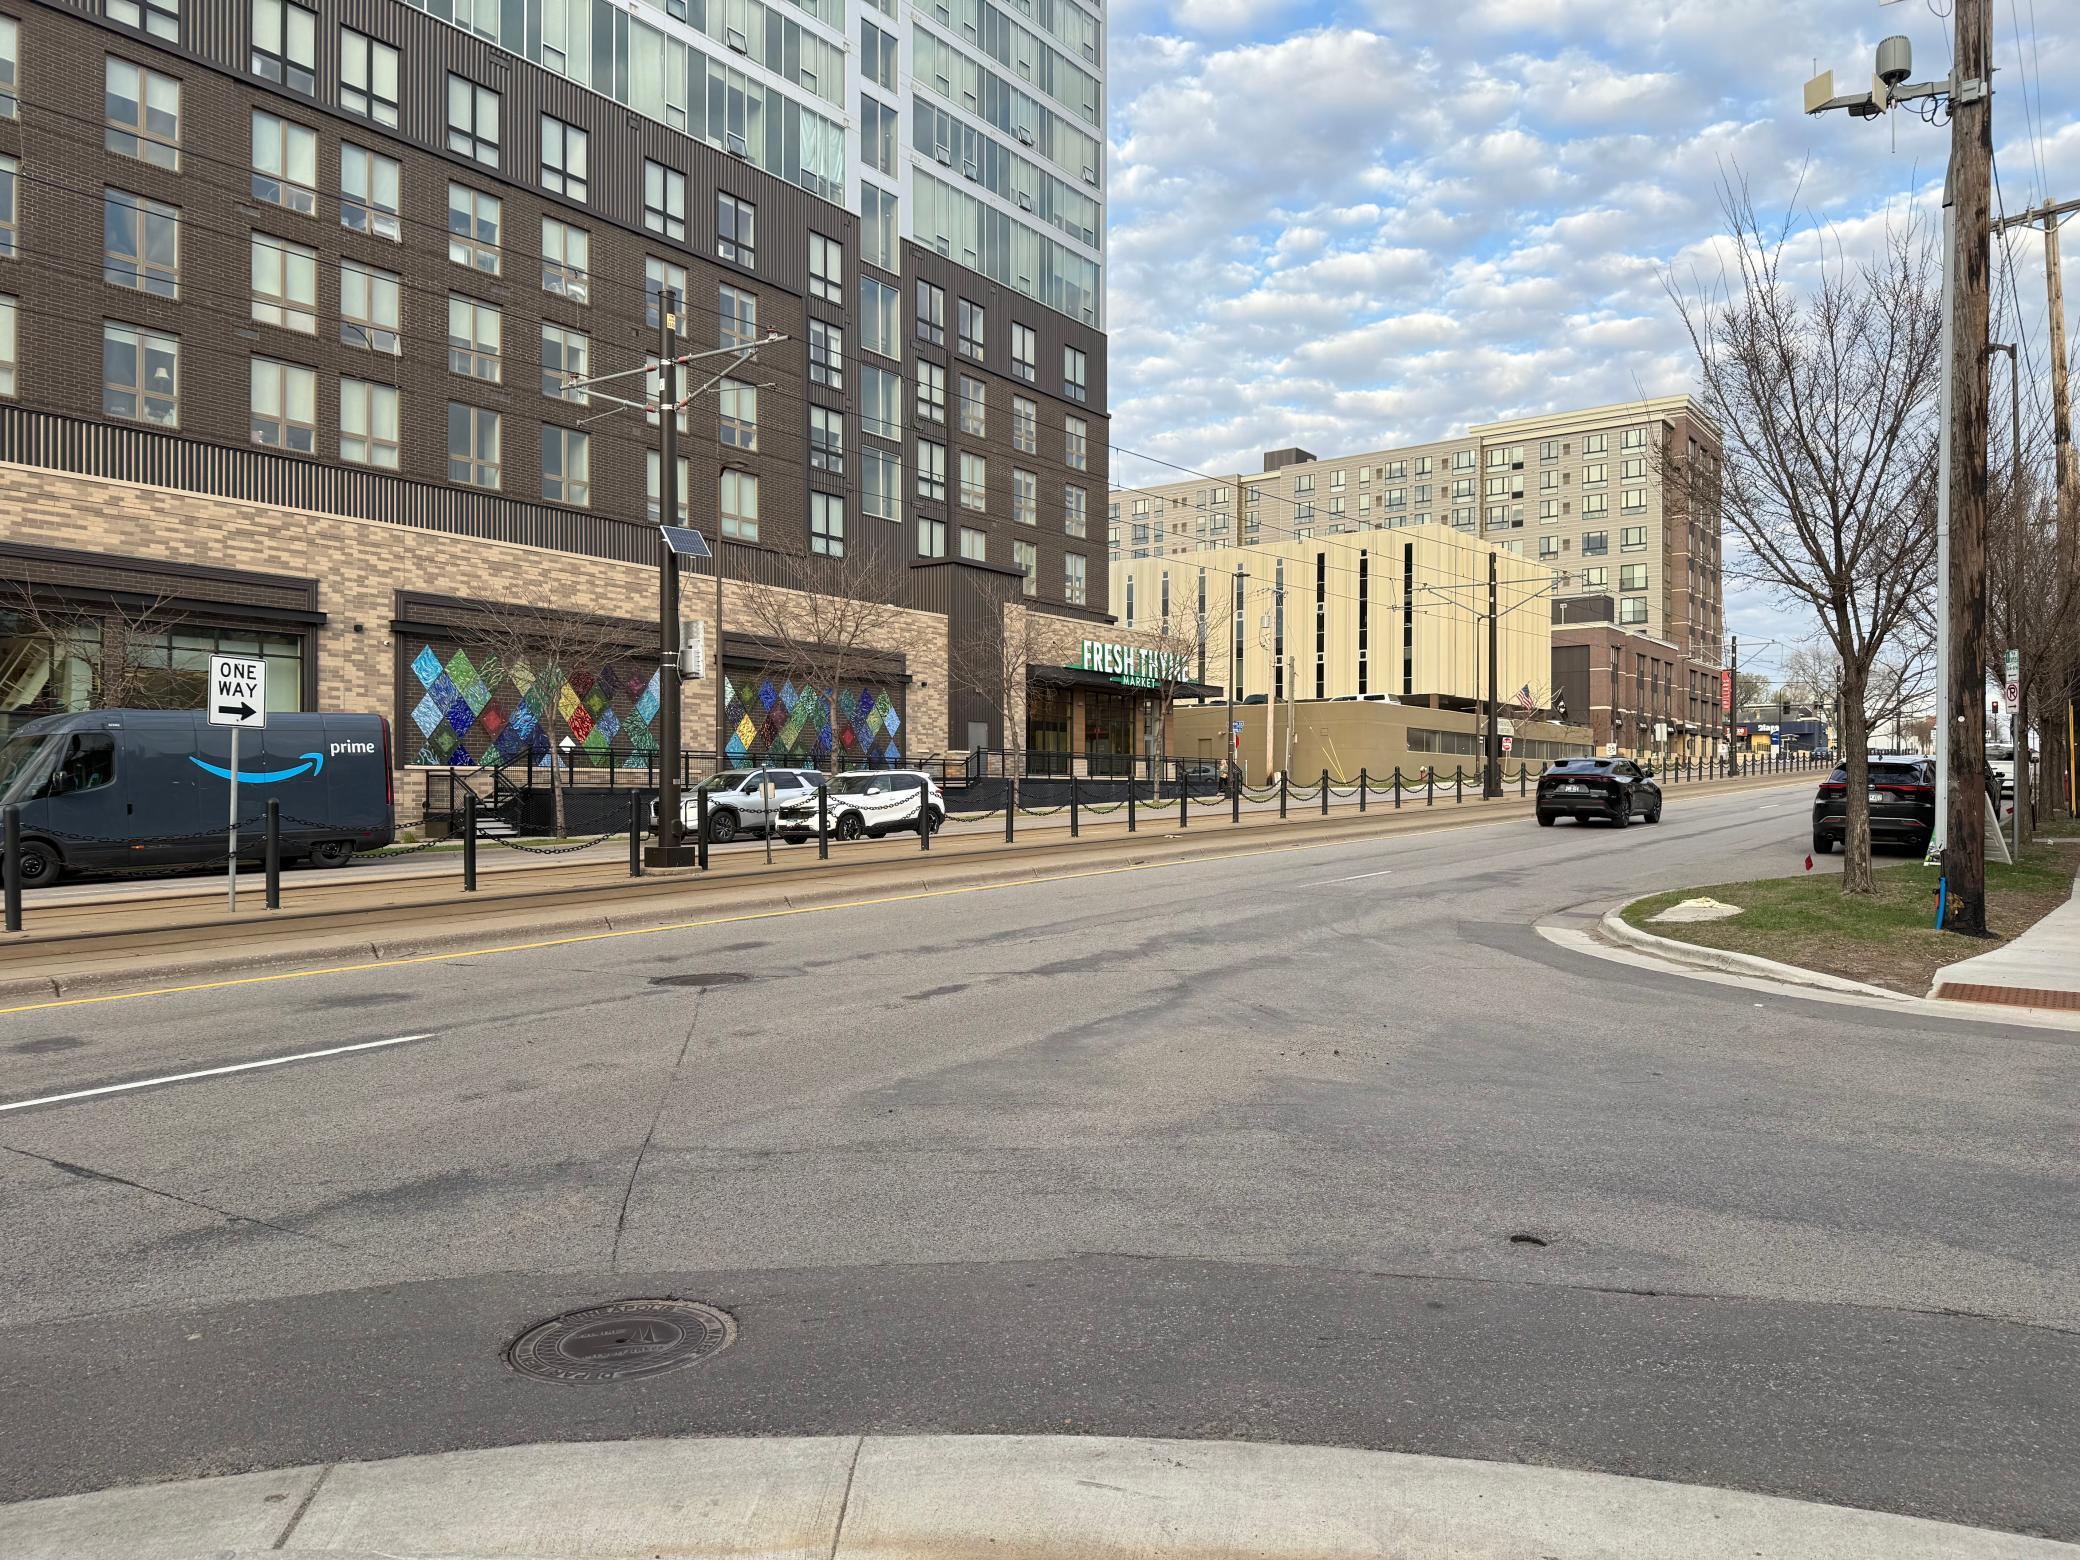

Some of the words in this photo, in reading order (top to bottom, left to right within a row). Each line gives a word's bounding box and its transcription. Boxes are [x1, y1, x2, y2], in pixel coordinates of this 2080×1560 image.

[1083, 640, 1134, 676] FRESH
[220, 662, 256, 680] ONE
[218, 680, 258, 698] WAY
[1123, 675, 1156, 689] MARKET
[330, 739, 375, 757] prime
